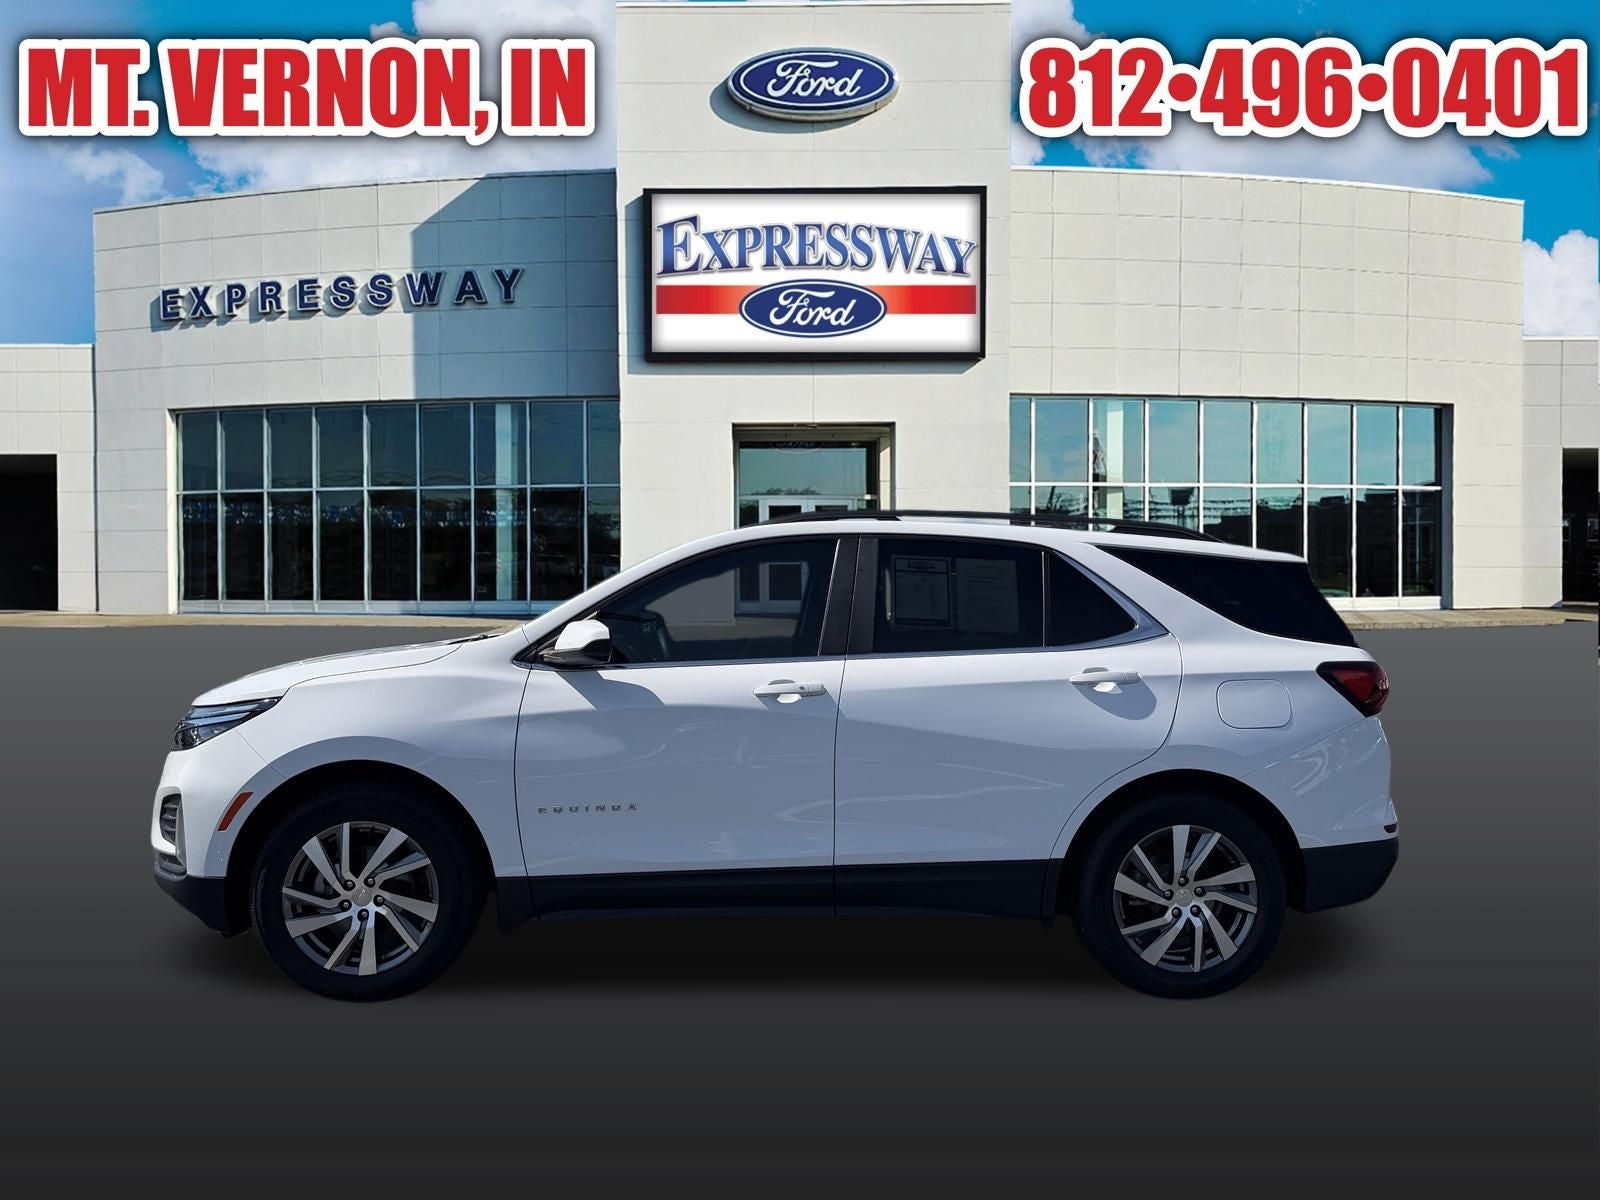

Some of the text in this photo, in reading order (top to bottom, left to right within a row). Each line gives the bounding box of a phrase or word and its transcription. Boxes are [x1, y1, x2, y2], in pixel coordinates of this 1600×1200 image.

[766, 59, 864, 98] Ford
[655, 213, 980, 278] EXPRESSWAY
[160, 268, 526, 322] EXPRESSWAY
[769, 287, 857, 327] Ford
[537, 803, 638, 814] EQUINOX
